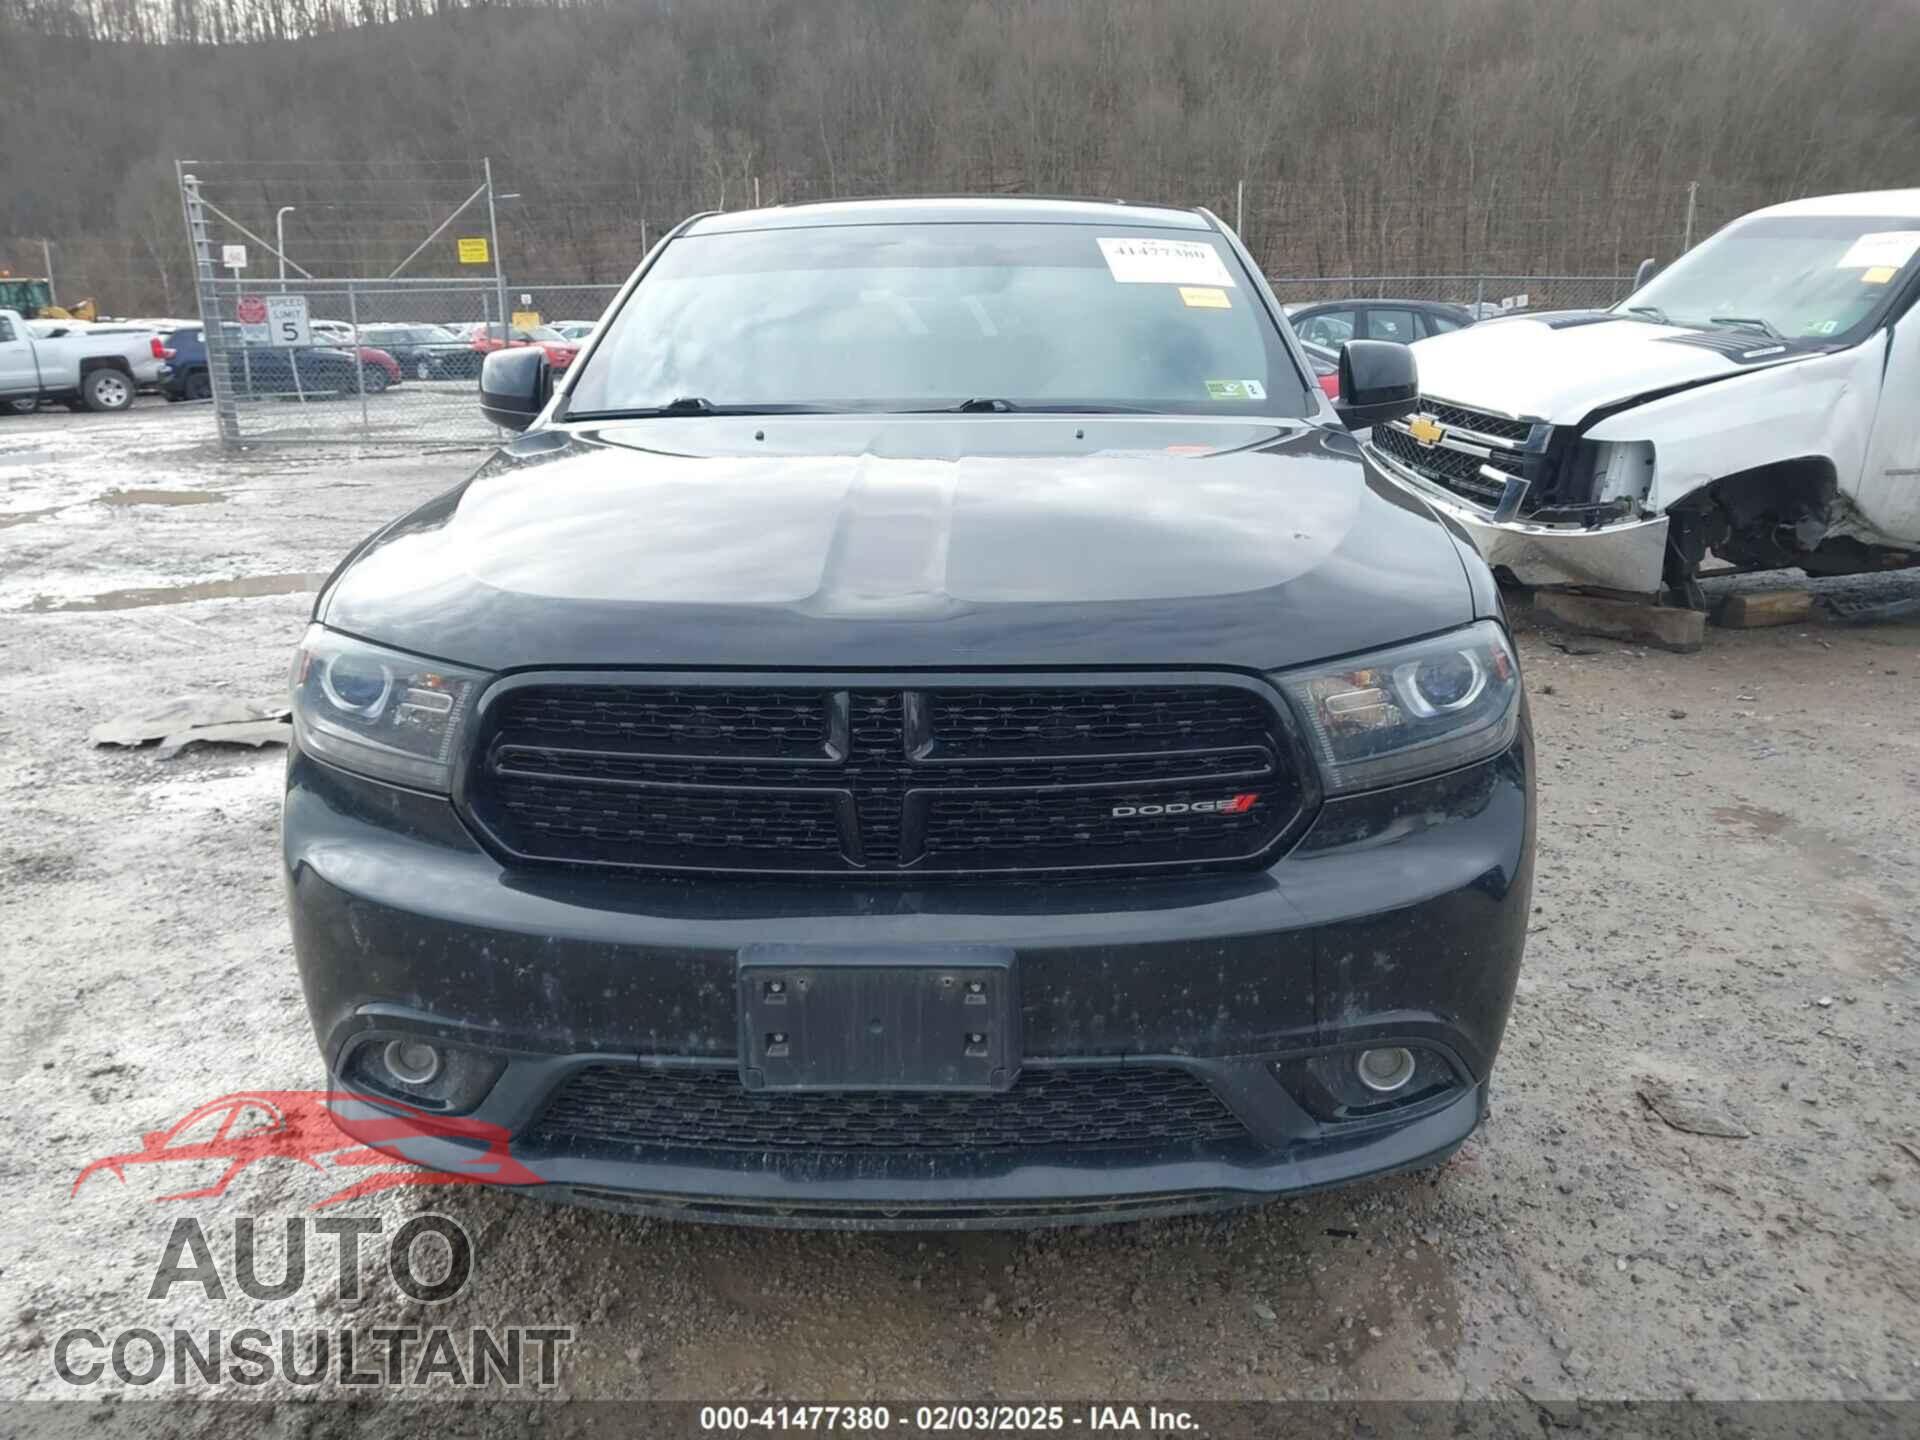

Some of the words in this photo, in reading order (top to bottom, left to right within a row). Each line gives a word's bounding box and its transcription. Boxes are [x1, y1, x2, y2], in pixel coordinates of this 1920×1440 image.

[273, 310, 302, 319] LIMIT
[282, 322, 299, 341] 5
[1112, 799, 1237, 817] DODGE
